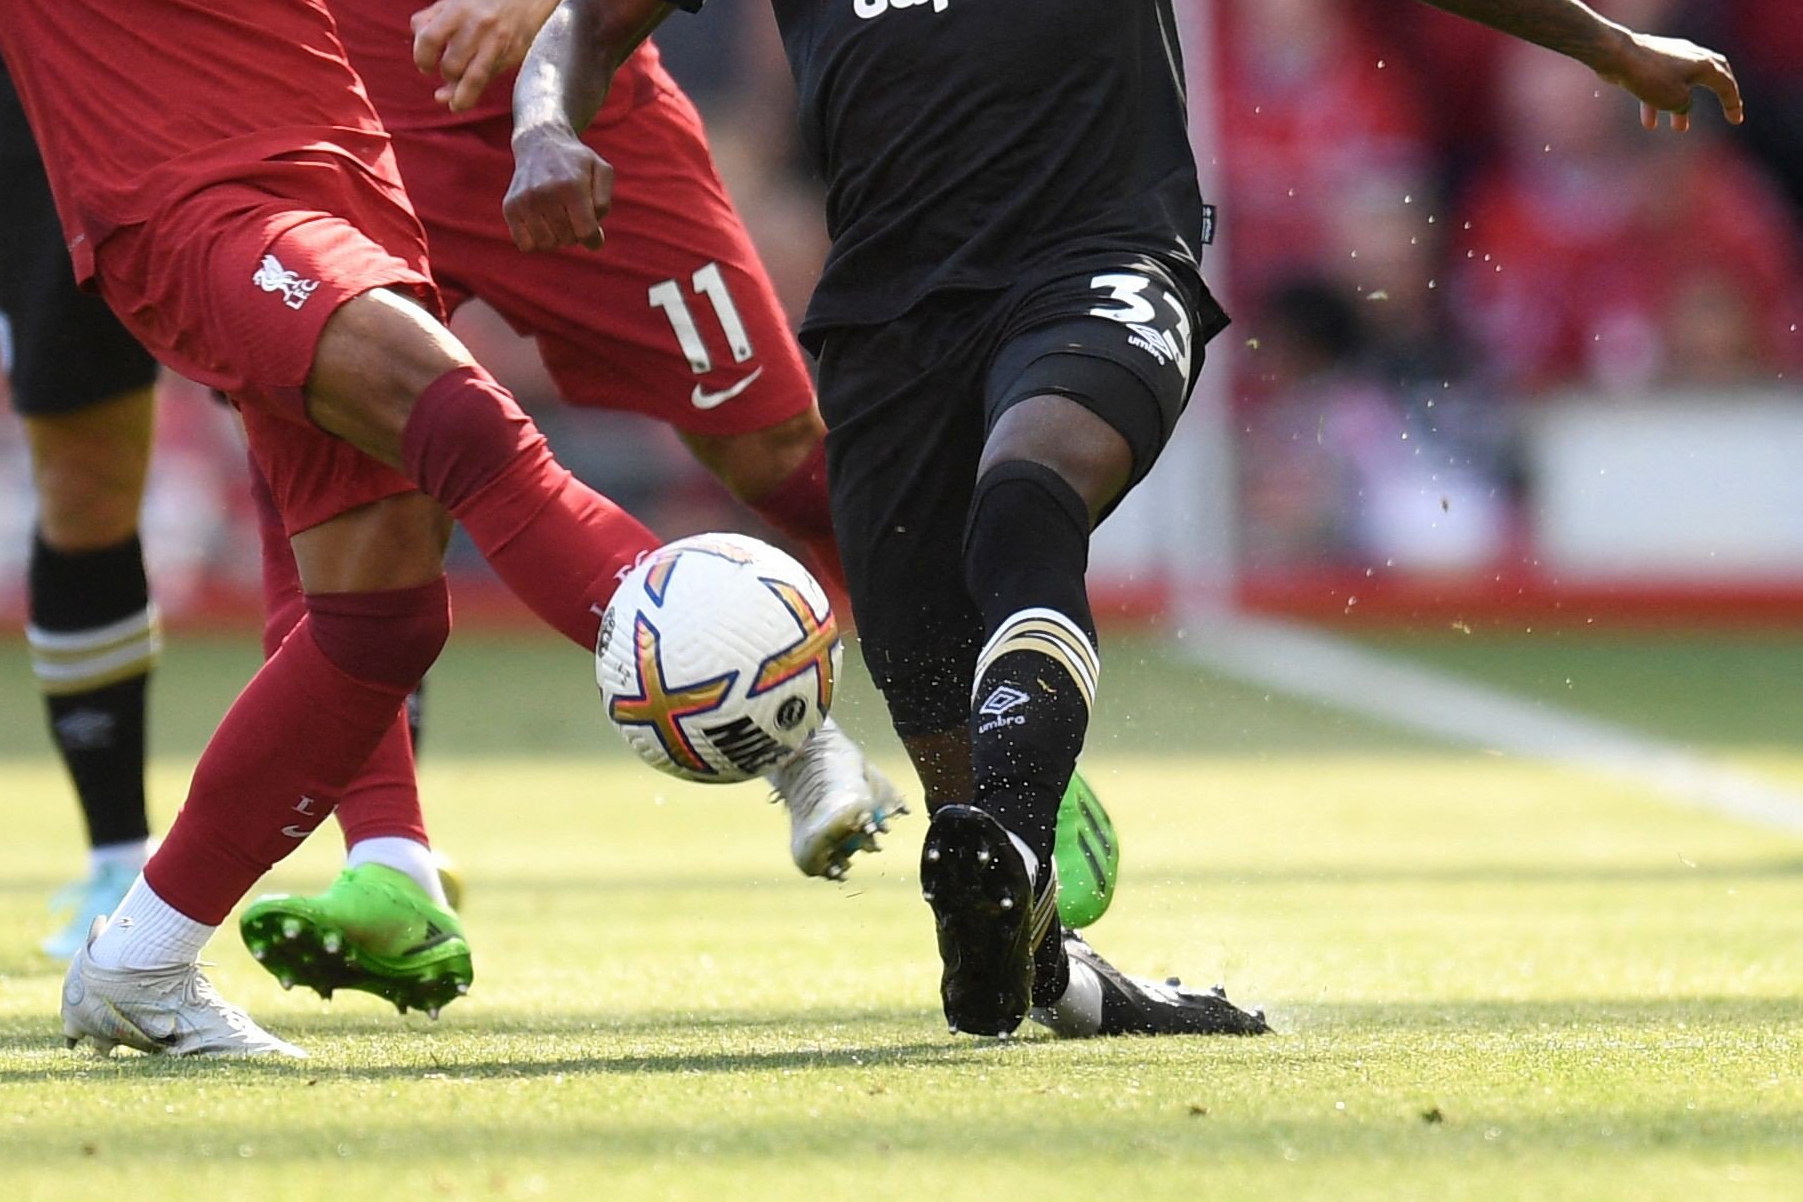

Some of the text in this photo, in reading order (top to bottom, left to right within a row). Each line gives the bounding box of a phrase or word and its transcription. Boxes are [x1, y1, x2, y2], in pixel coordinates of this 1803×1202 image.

[648, 261, 754, 374] 11
[1127, 334, 1166, 366] umbro
[978, 713, 1026, 735] umbro
